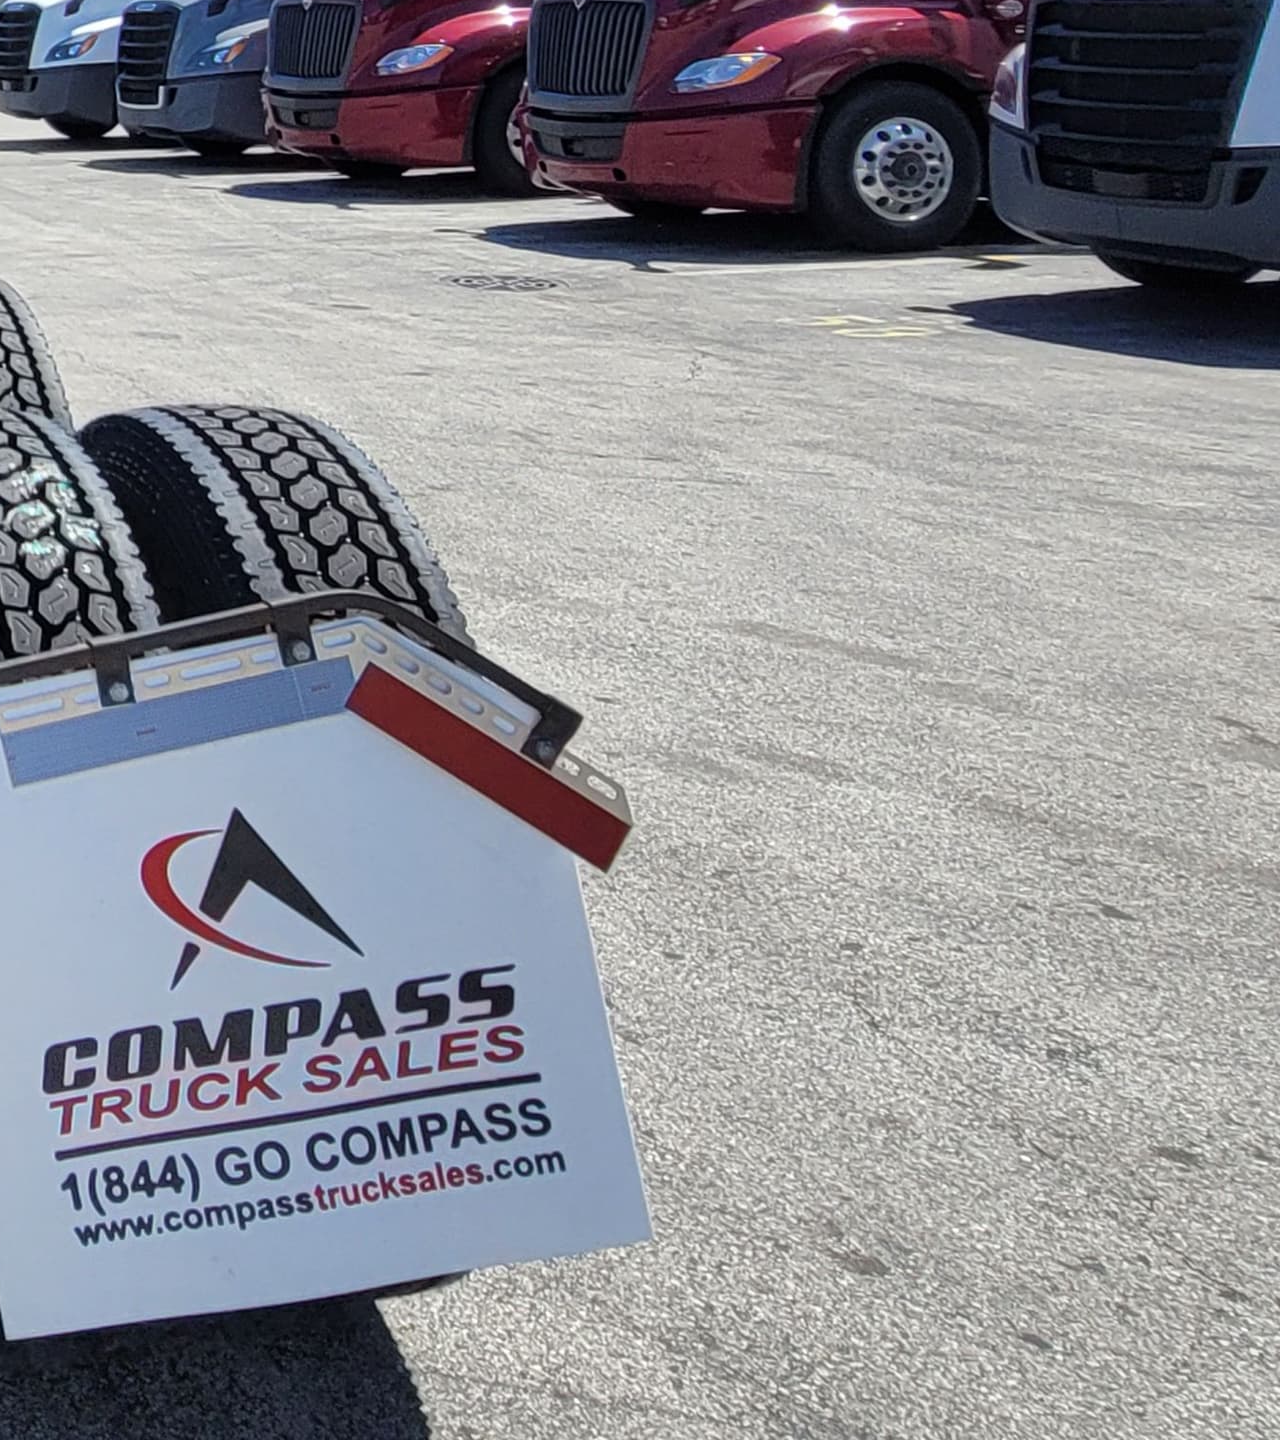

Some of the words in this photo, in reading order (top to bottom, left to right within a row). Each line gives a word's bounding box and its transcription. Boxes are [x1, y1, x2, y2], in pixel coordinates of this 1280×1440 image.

[42, 963, 516, 1095] COMPASS
[49, 1062, 282, 1135] TRUCK
[302, 1024, 525, 1093] SALES
[60, 1152, 201, 1217] 1(844)
[214, 1140, 291, 1187] GO
[305, 1097, 552, 1172] COMPASS
[73, 1150, 567, 1247] www.compasstrucksales.com
